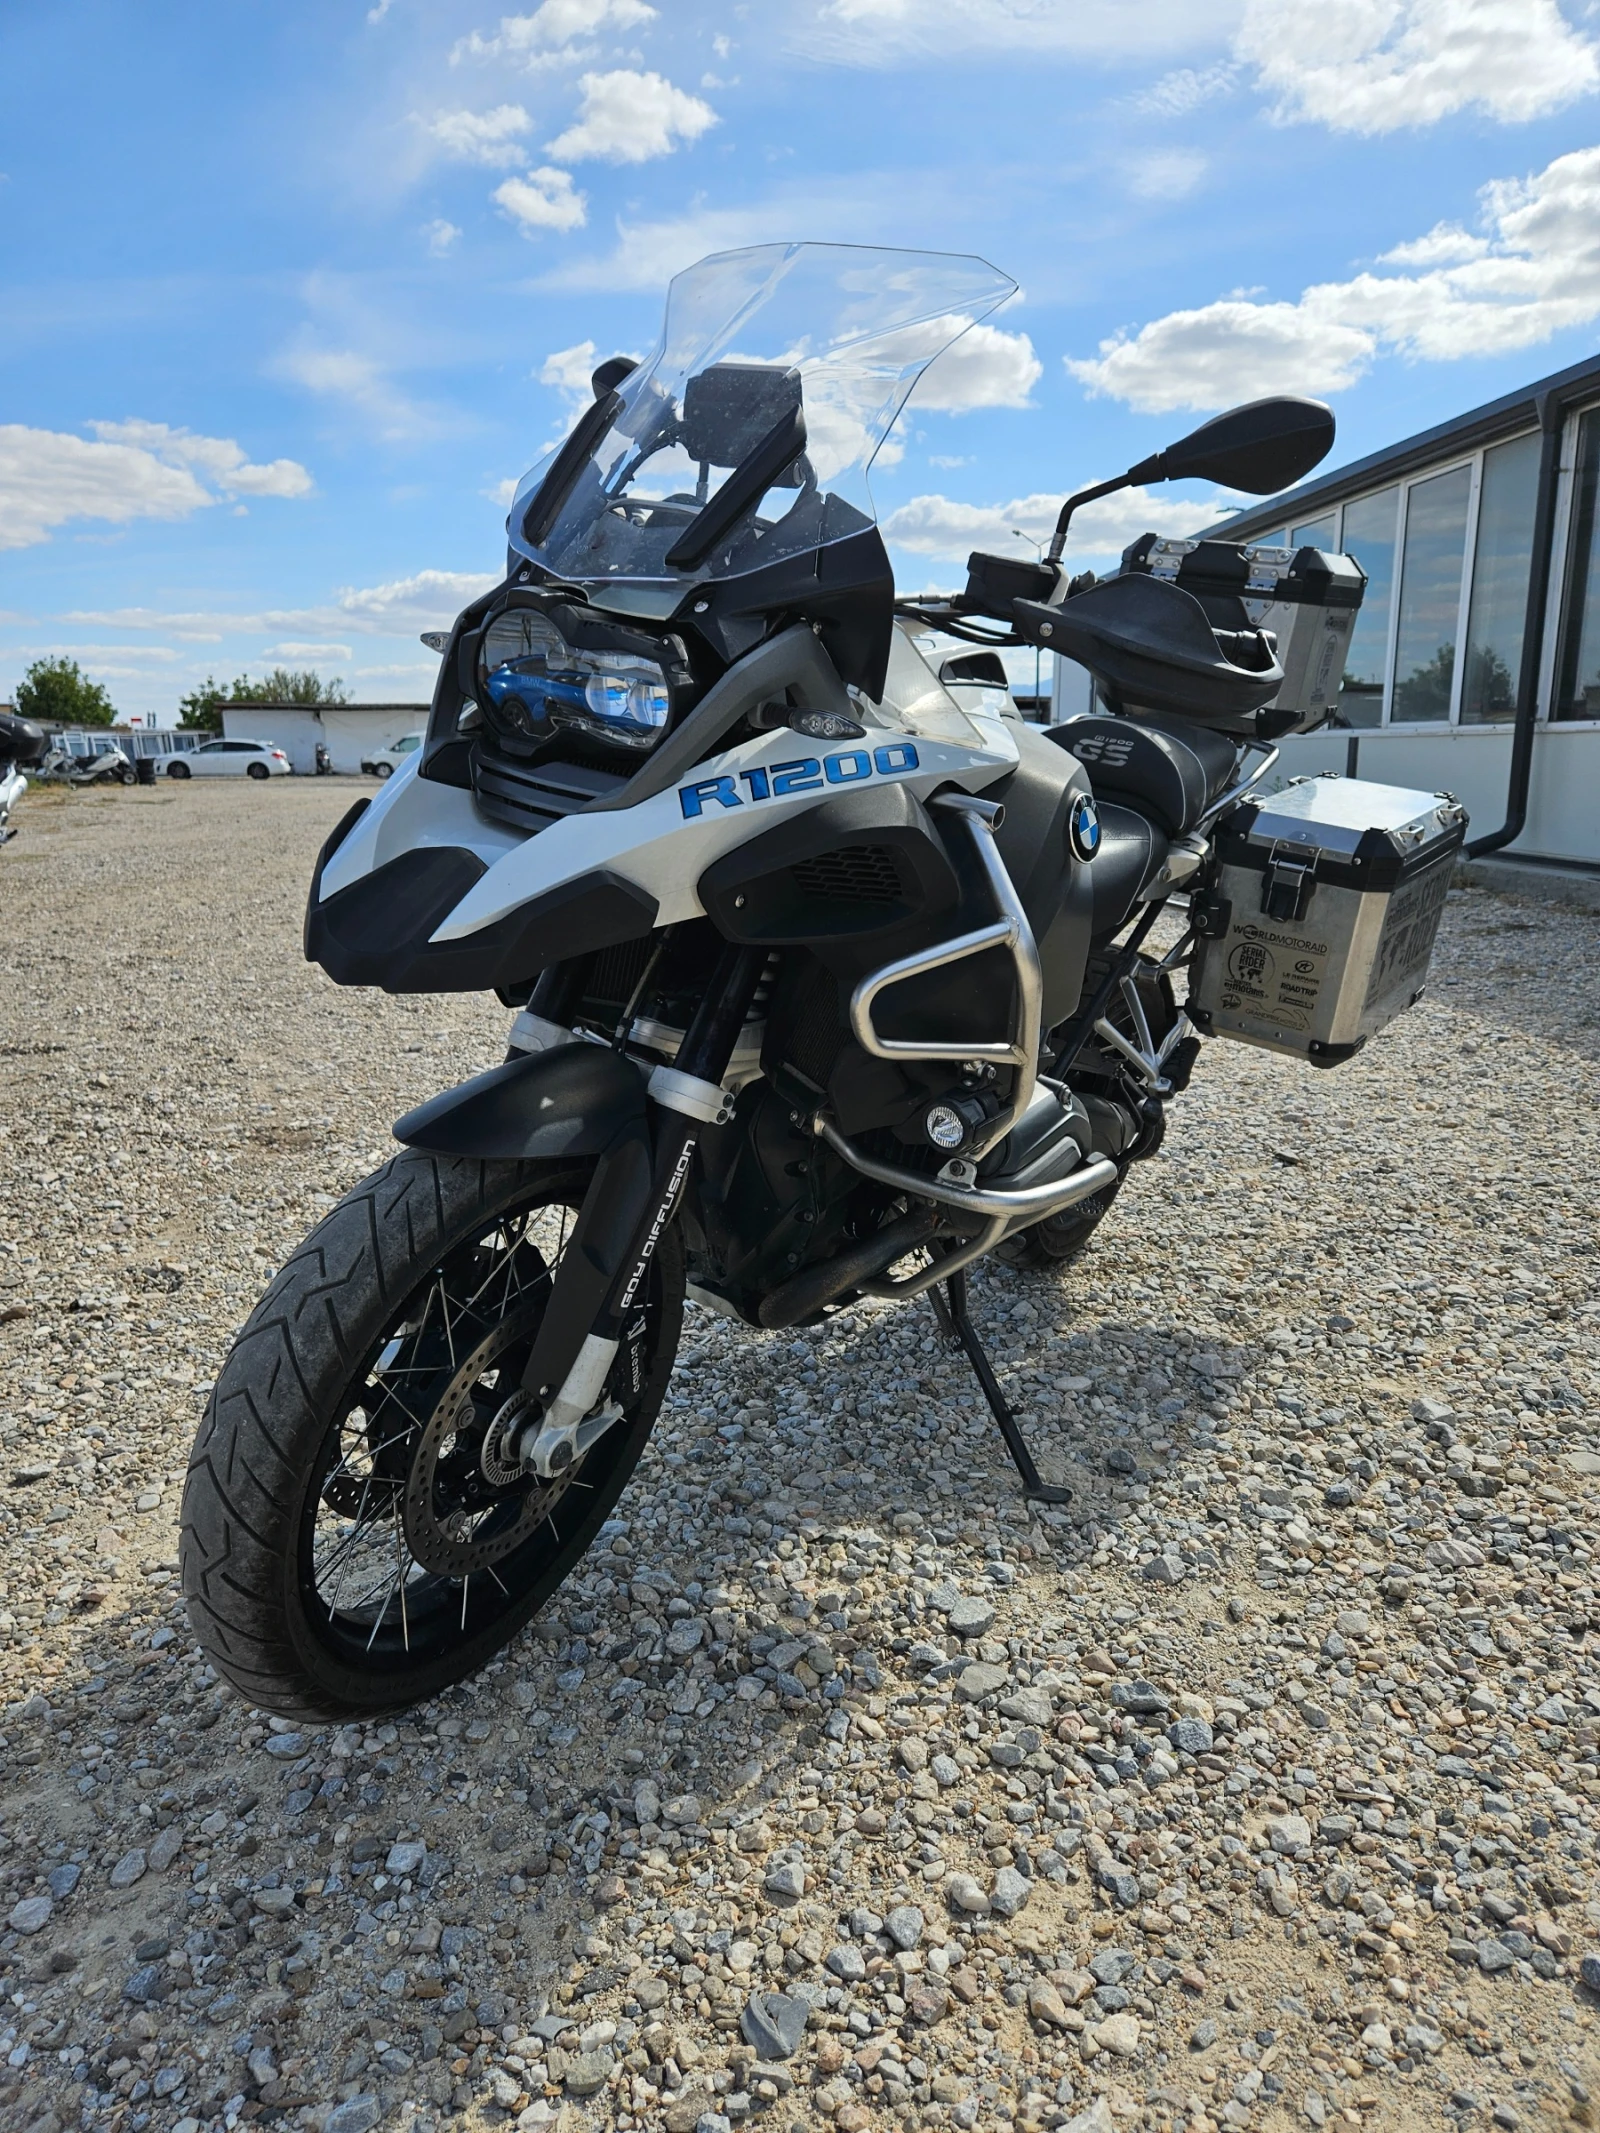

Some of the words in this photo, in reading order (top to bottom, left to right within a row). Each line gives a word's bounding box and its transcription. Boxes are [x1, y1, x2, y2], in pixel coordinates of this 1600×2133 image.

[1073, 738, 1133, 767] GS
[1094, 734, 1135, 746] R1200
[678, 743, 920, 820] R1200
[1073, 795, 1098, 824] BMW
[1239, 955, 1266, 969] RIDER
[1242, 946, 1267, 960] SERIAL
[620, 1261, 646, 1308] GOY
[631, 1342, 642, 1393] brembo
